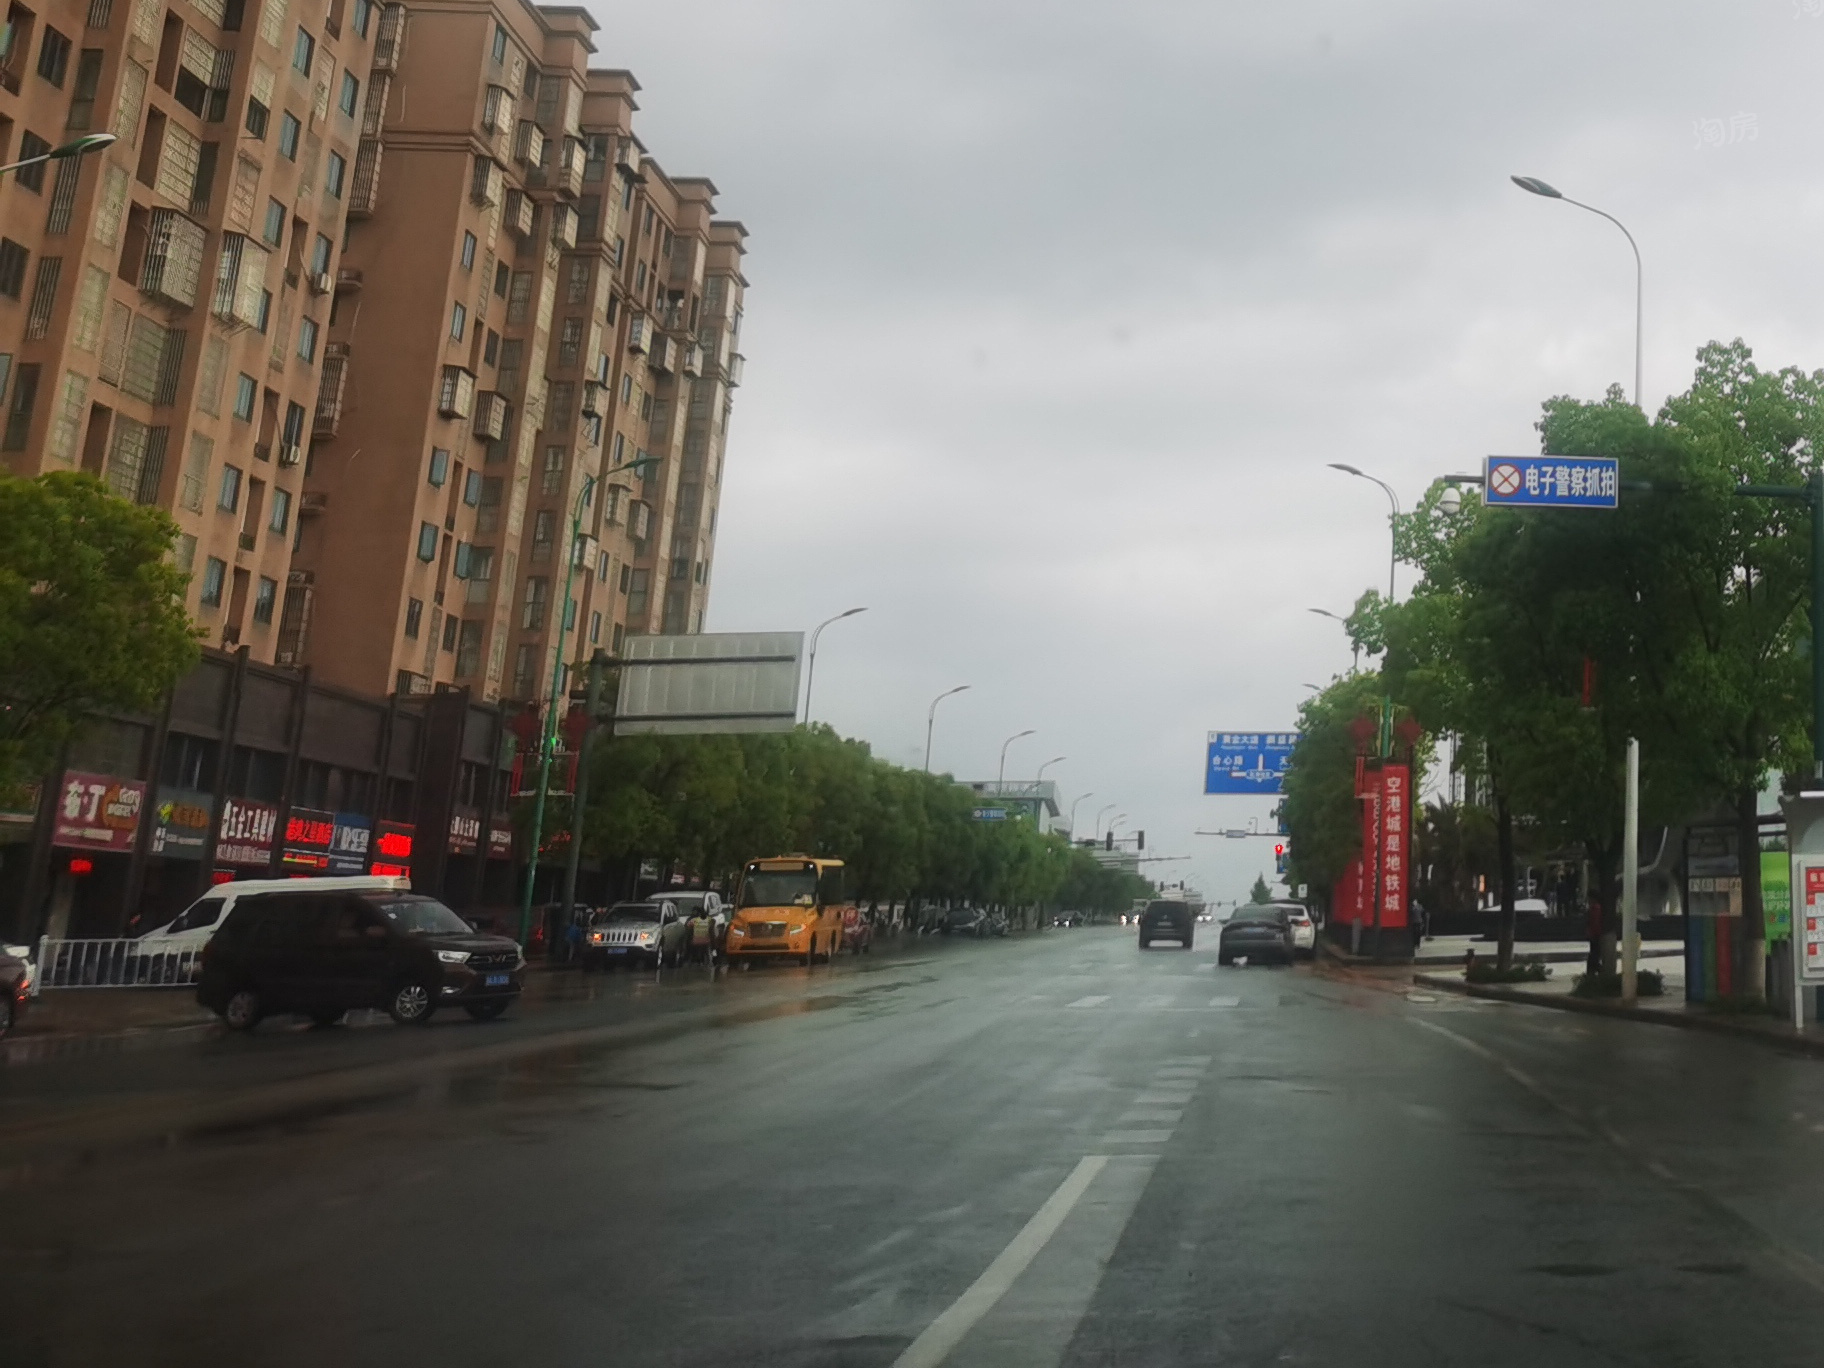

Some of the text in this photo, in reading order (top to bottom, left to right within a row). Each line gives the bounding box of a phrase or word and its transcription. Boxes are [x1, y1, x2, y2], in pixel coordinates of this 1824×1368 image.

[1525, 463, 1615, 498] 电子警察抓拍
[1384, 776, 1403, 912] 空港城是地铁城
